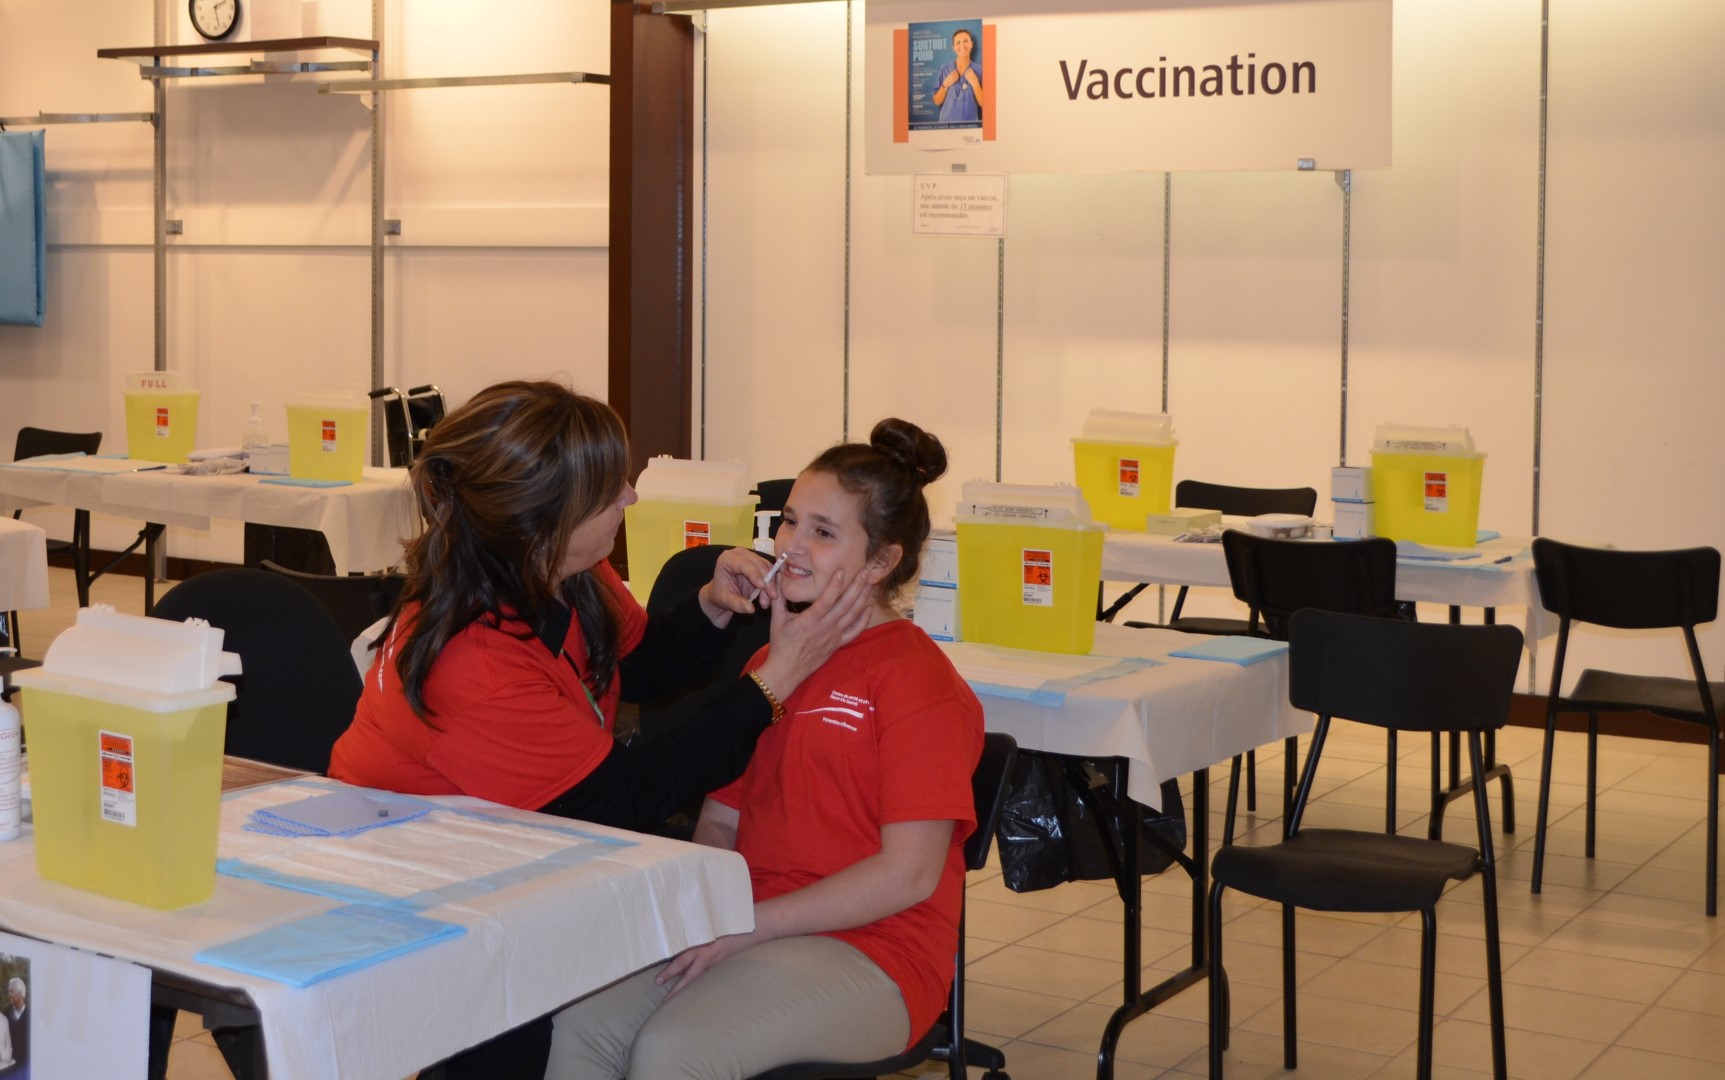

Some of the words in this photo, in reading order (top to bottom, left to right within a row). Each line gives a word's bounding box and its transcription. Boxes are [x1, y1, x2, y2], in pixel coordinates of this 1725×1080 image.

[913, 38, 947, 50] SURTOUT
[913, 50, 933, 61] POUR
[1058, 53, 1317, 101] Vaccination
[141, 379, 167, 388] FULL
